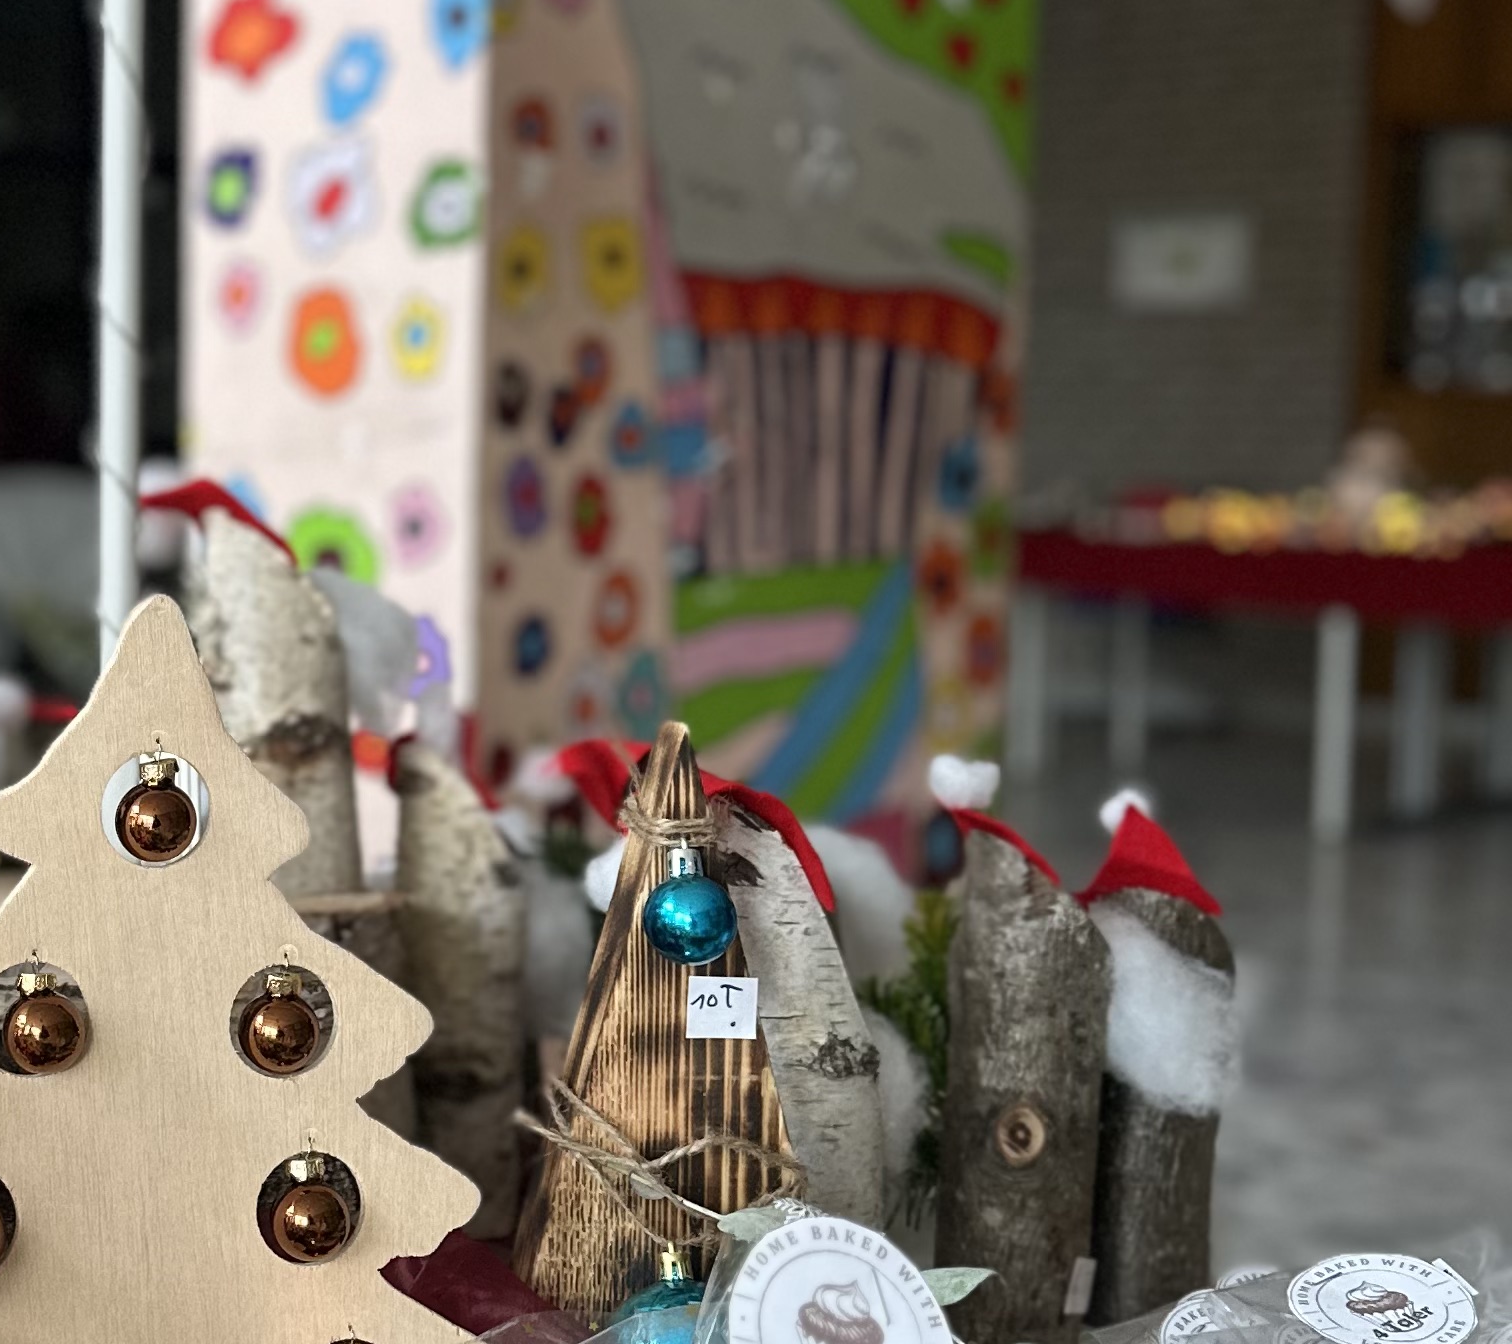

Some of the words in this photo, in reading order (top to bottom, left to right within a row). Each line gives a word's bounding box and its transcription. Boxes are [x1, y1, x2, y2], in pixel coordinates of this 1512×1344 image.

[744, 1231, 799, 1281] HOME
[811, 1226, 888, 1260] BAKED
[898, 1264, 943, 1329] WITH
[1298, 1280, 1315, 1306] HOME
[1314, 1258, 1370, 1278] BAKED
[1382, 1258, 1433, 1278] WITH
[1380, 1306, 1434, 1332] Taler
[1437, 1319, 1466, 1344] CARE
